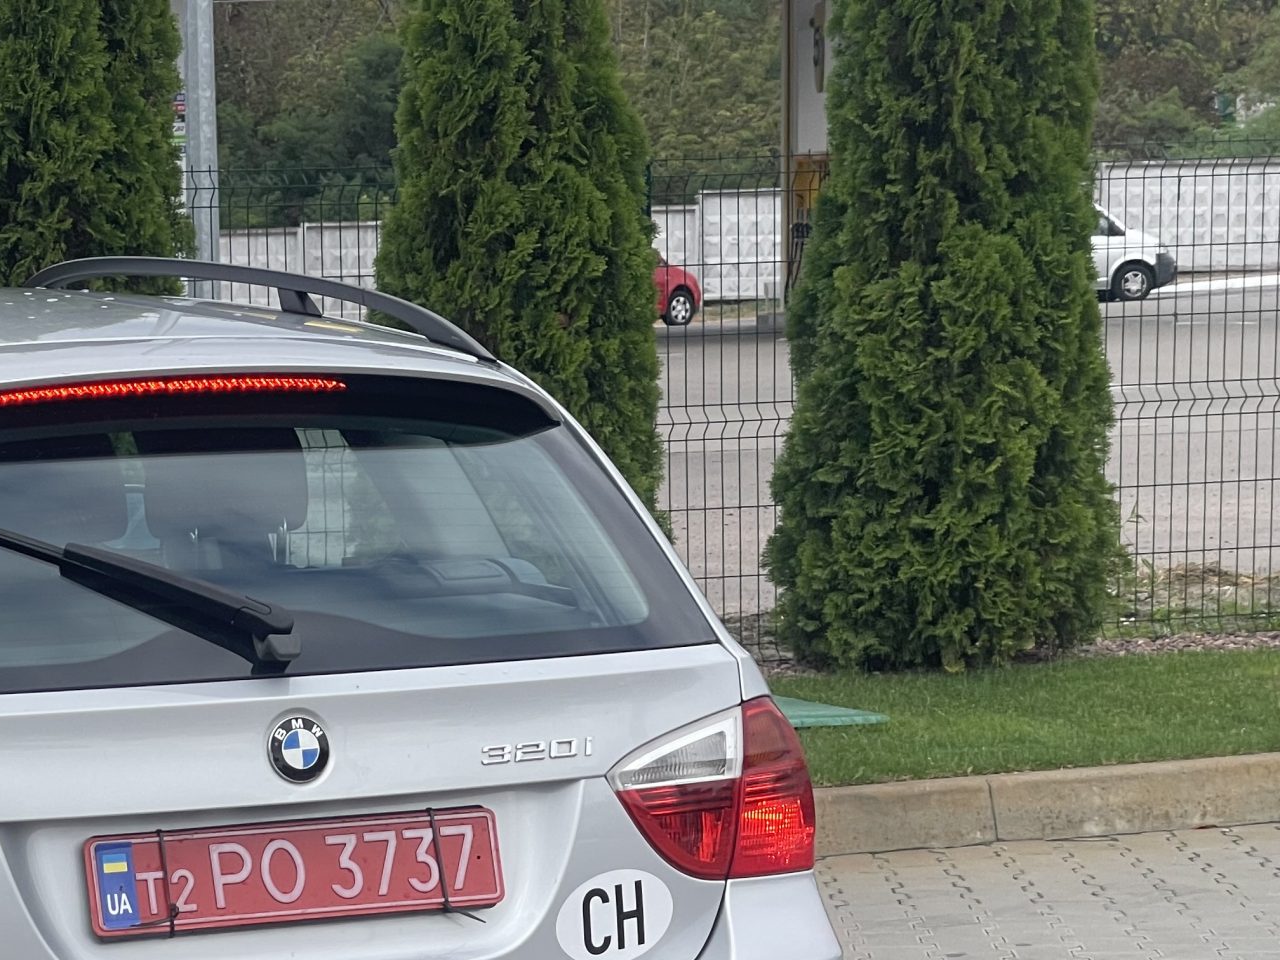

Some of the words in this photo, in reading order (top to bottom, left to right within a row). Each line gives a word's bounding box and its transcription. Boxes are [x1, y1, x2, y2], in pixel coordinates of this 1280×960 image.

[274, 718, 323, 741] BMW
[481, 737, 593, 766] 320i
[208, 838, 307, 908] PO
[324, 825, 474, 899] 3737
[107, 893, 133, 916] UA
[582, 880, 645, 955] CH
